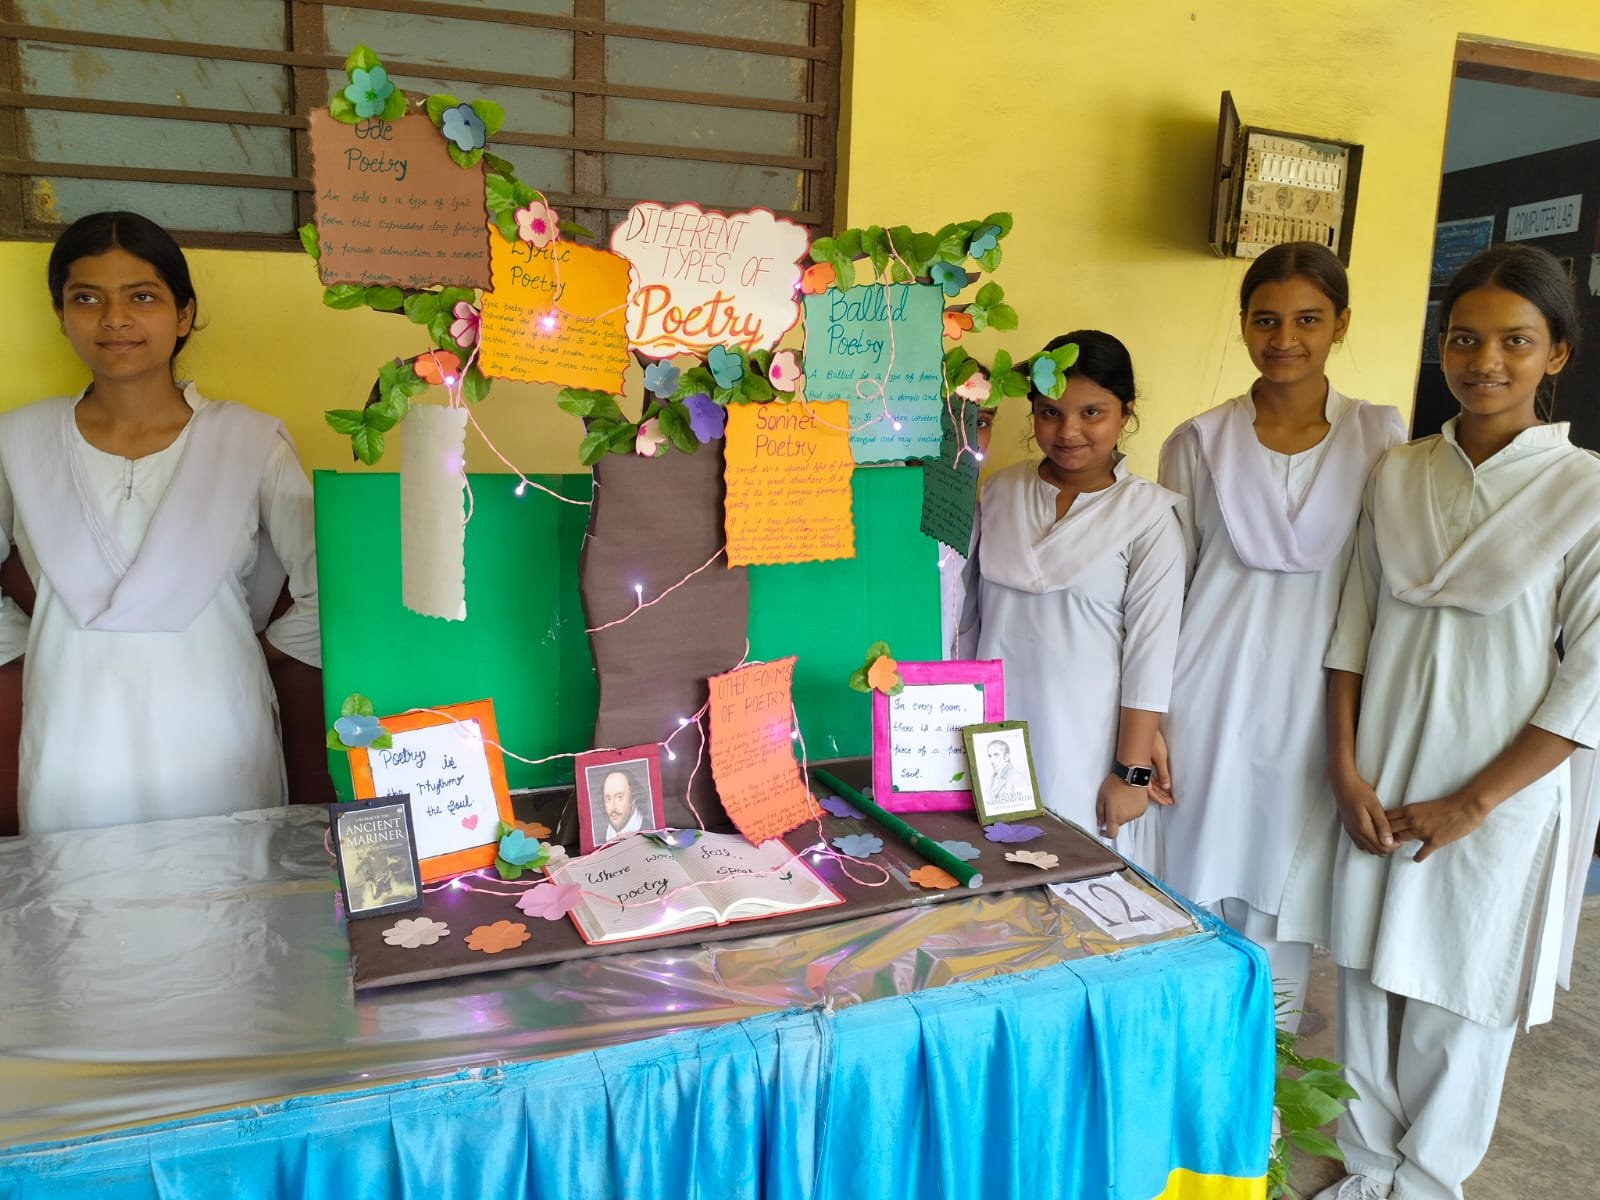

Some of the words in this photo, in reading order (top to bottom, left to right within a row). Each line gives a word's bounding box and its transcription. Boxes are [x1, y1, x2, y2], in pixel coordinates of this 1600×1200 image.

[355, 119, 394, 141] Ode
[344, 148, 408, 181] Poetry
[408, 193, 428, 210] type
[626, 206, 750, 252] DIFFERENT
[1514, 206, 1557, 237] COMPUTER
[1557, 203, 1574, 230] LAB
[661, 246, 732, 284] TYPES
[740, 256, 775, 287] OF
[511, 266, 566, 301] Poetry
[633, 284, 764, 351] Poetry
[828, 285, 909, 323] Ballad
[828, 324, 884, 364] Poetry
[808, 369, 818, 379] A
[755, 405, 817, 430] Sonnet
[755, 434, 817, 463] Poetry
[718, 672, 749, 700] OTHER
[753, 664, 793, 686] FORMS
[721, 703, 736, 724] OF
[745, 691, 787, 715] POETRY
[912, 702, 933, 715] every
[379, 747, 427, 769] Poetry
[441, 754, 457, 770] is
[345, 817, 401, 836] ANCIENT
[426, 804, 443, 817] the
[347, 829, 404, 848] MARINER
[586, 866, 631, 884] Where
[617, 878, 669, 912] poetry
[1064, 883, 1155, 927] 12
